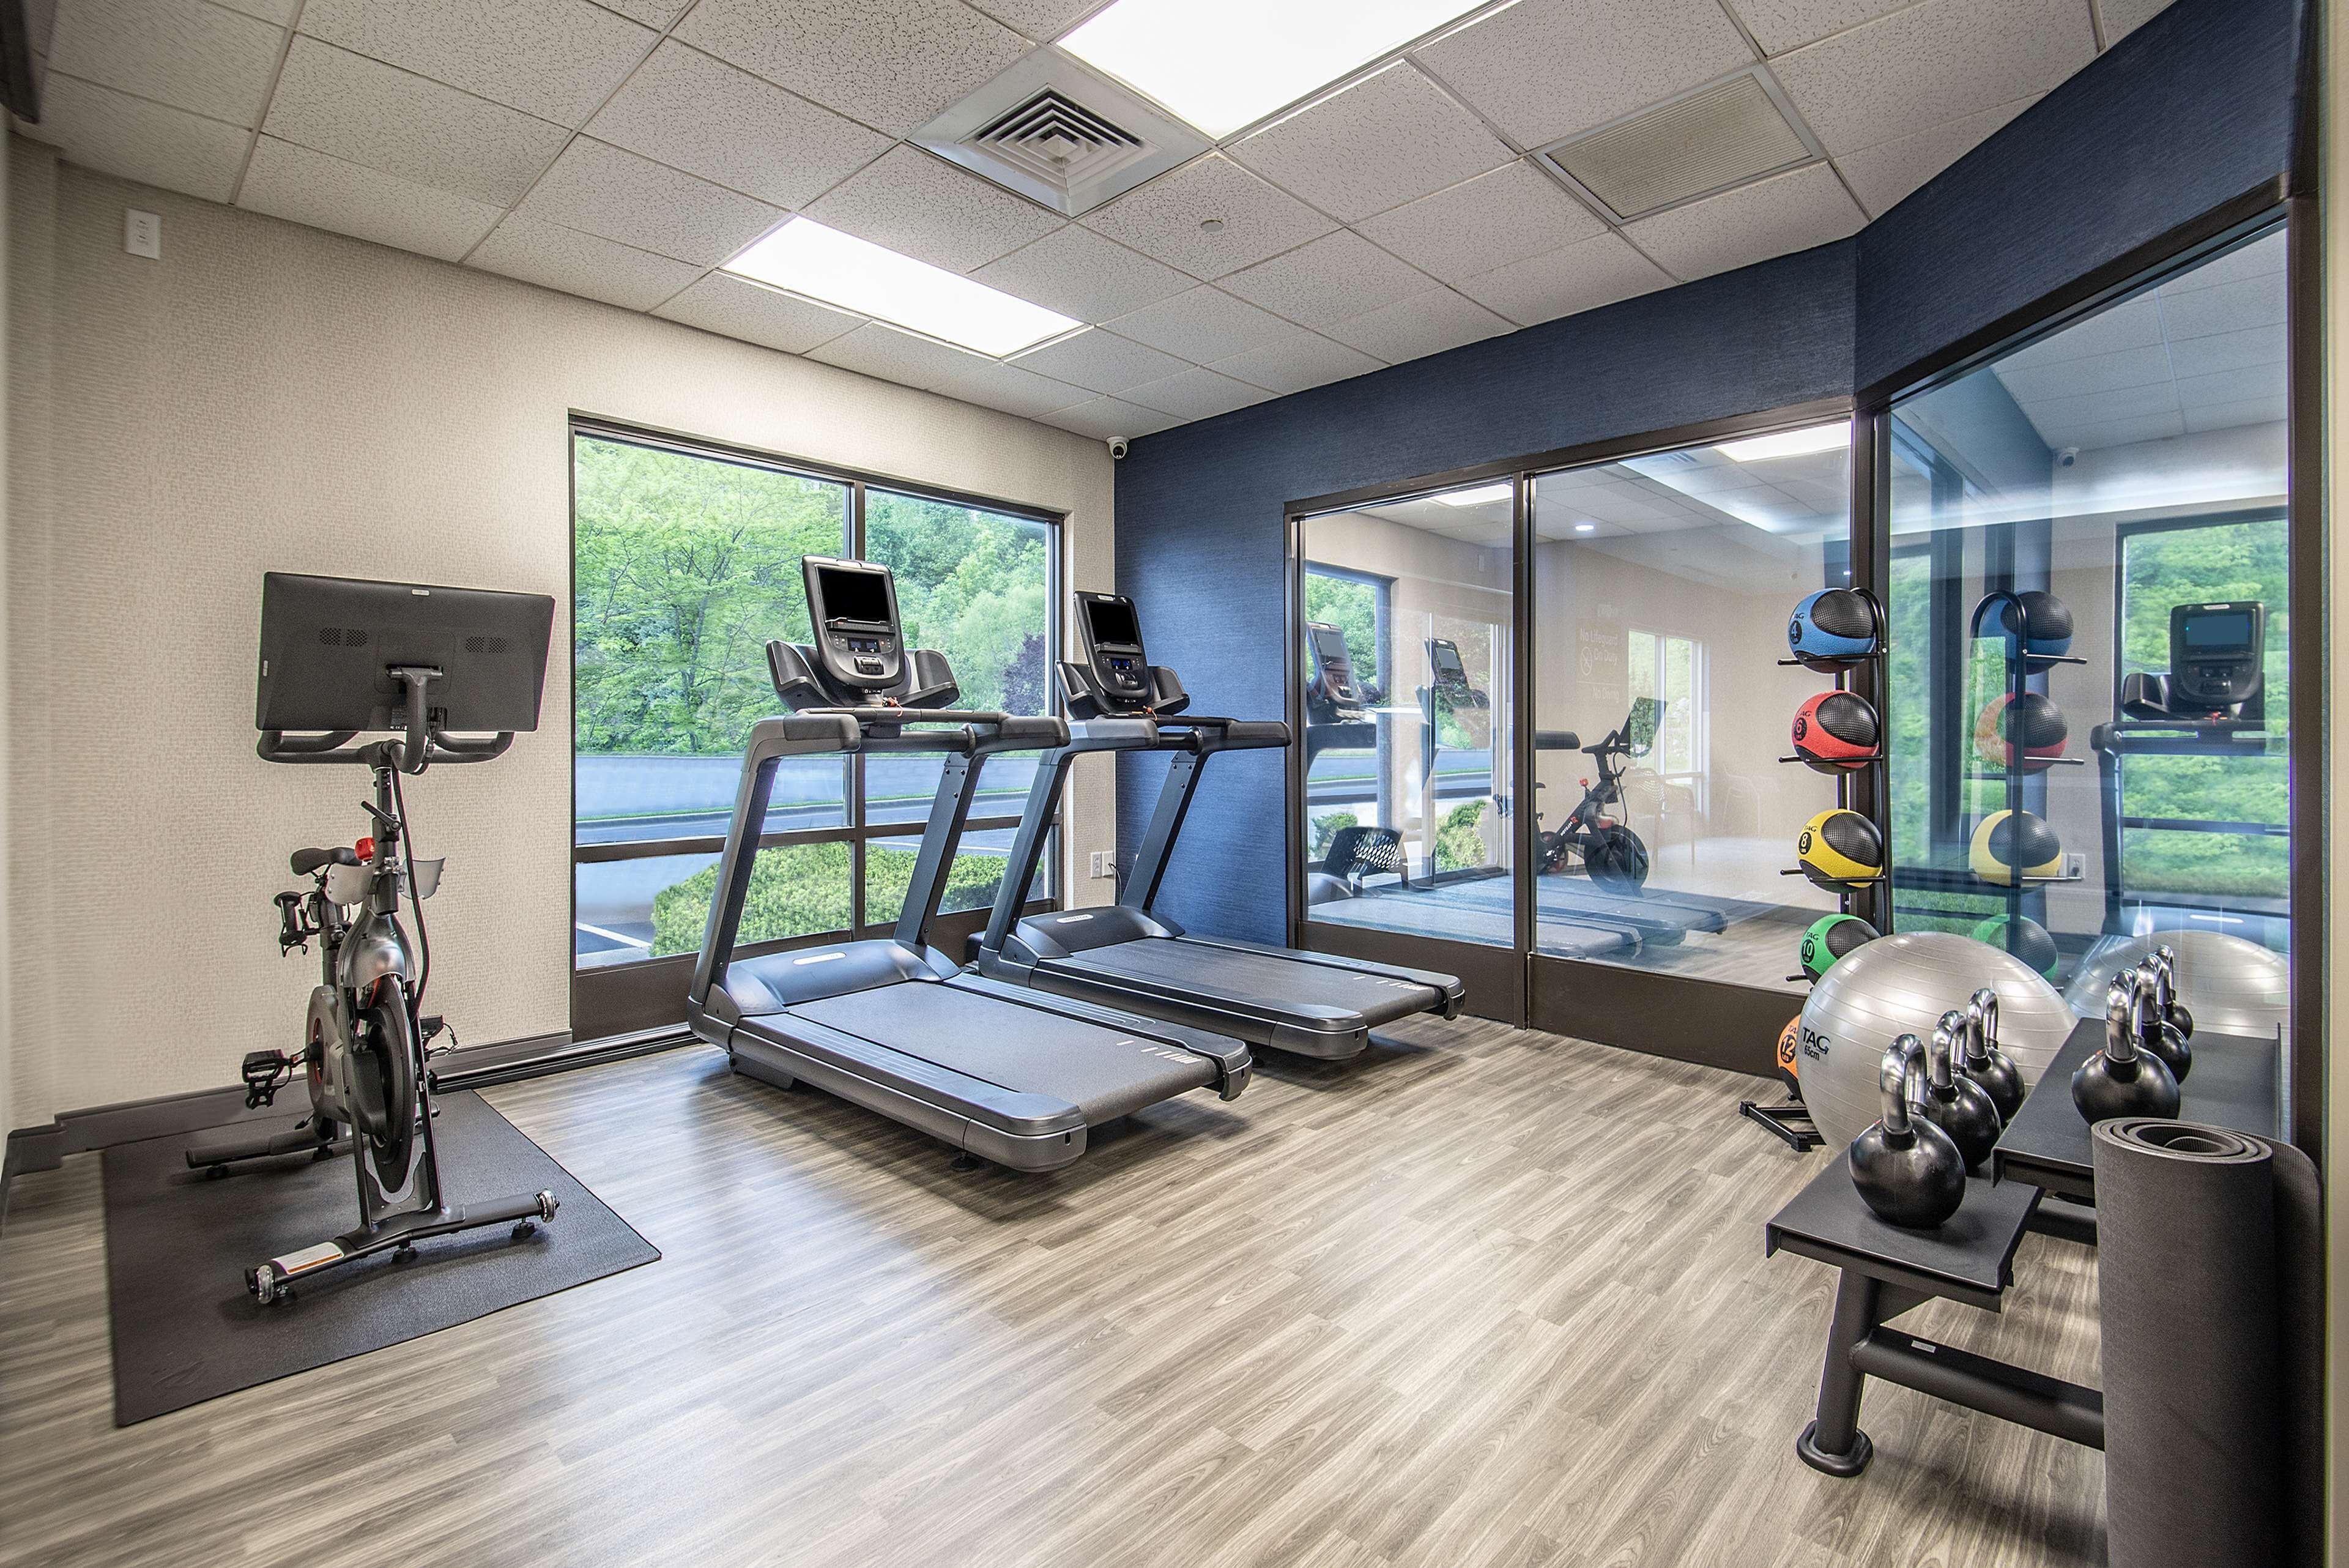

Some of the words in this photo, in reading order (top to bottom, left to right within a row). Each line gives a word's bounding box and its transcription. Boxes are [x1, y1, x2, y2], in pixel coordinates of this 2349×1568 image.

[1580, 626, 1589, 642] No
[1590, 628, 1618, 647] Lifeguard
[1791, 622, 1797, 637] 4
[1796, 719, 1803, 734] 6
[1801, 833, 1808, 848] 8
[1806, 932, 1820, 941] TAG
[1803, 942, 1813, 956] 10
[1782, 1036, 1796, 1057] 12
[1803, 1026, 1831, 1055] TAG
[1804, 1044, 1820, 1061] 65cm
